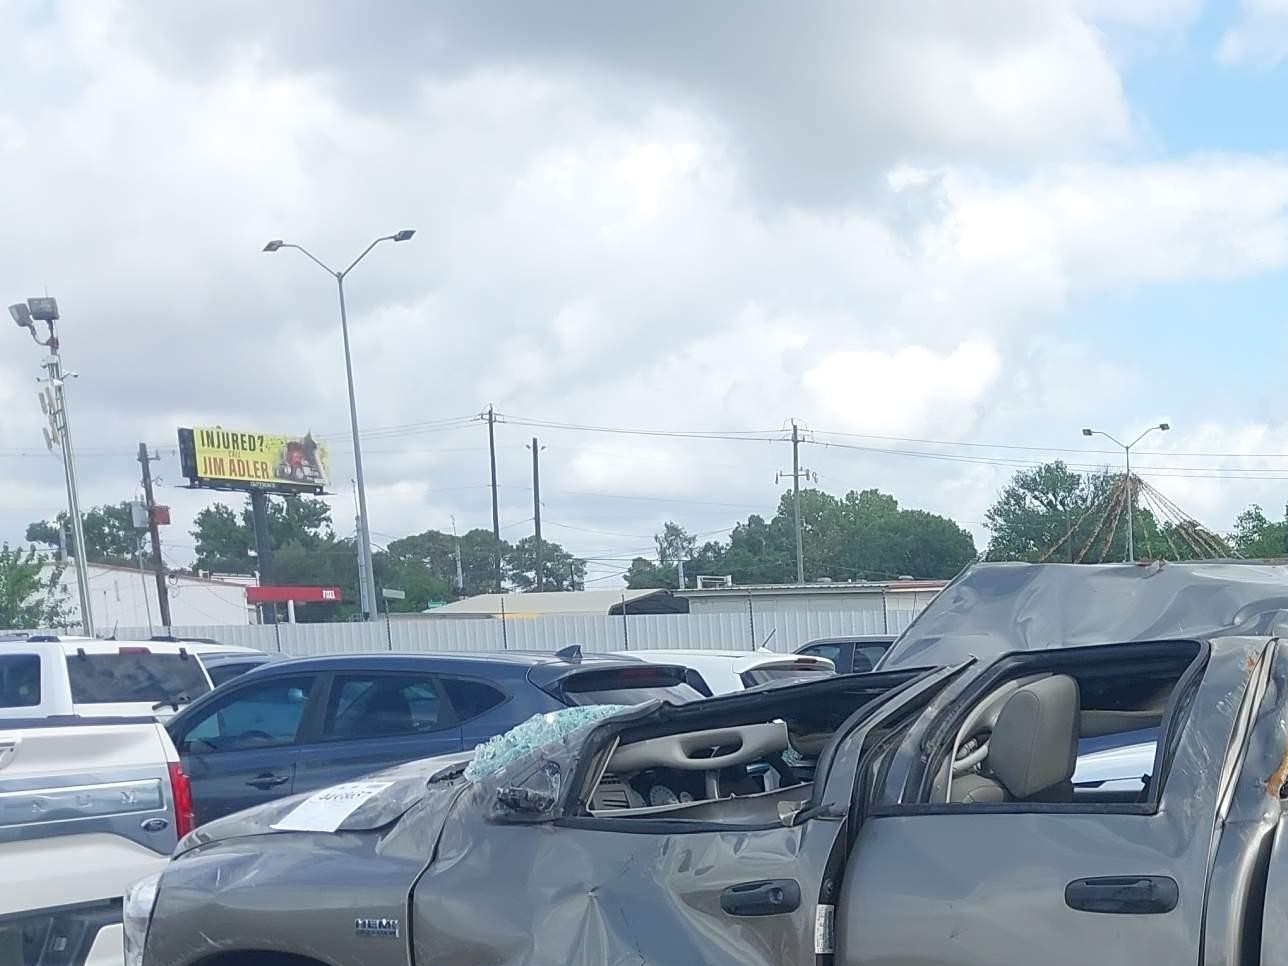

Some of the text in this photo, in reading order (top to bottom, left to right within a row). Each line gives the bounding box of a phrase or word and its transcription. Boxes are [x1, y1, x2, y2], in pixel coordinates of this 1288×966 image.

[200, 429, 264, 453] INJURED?
[203, 456, 270, 480] JIM ADLER
